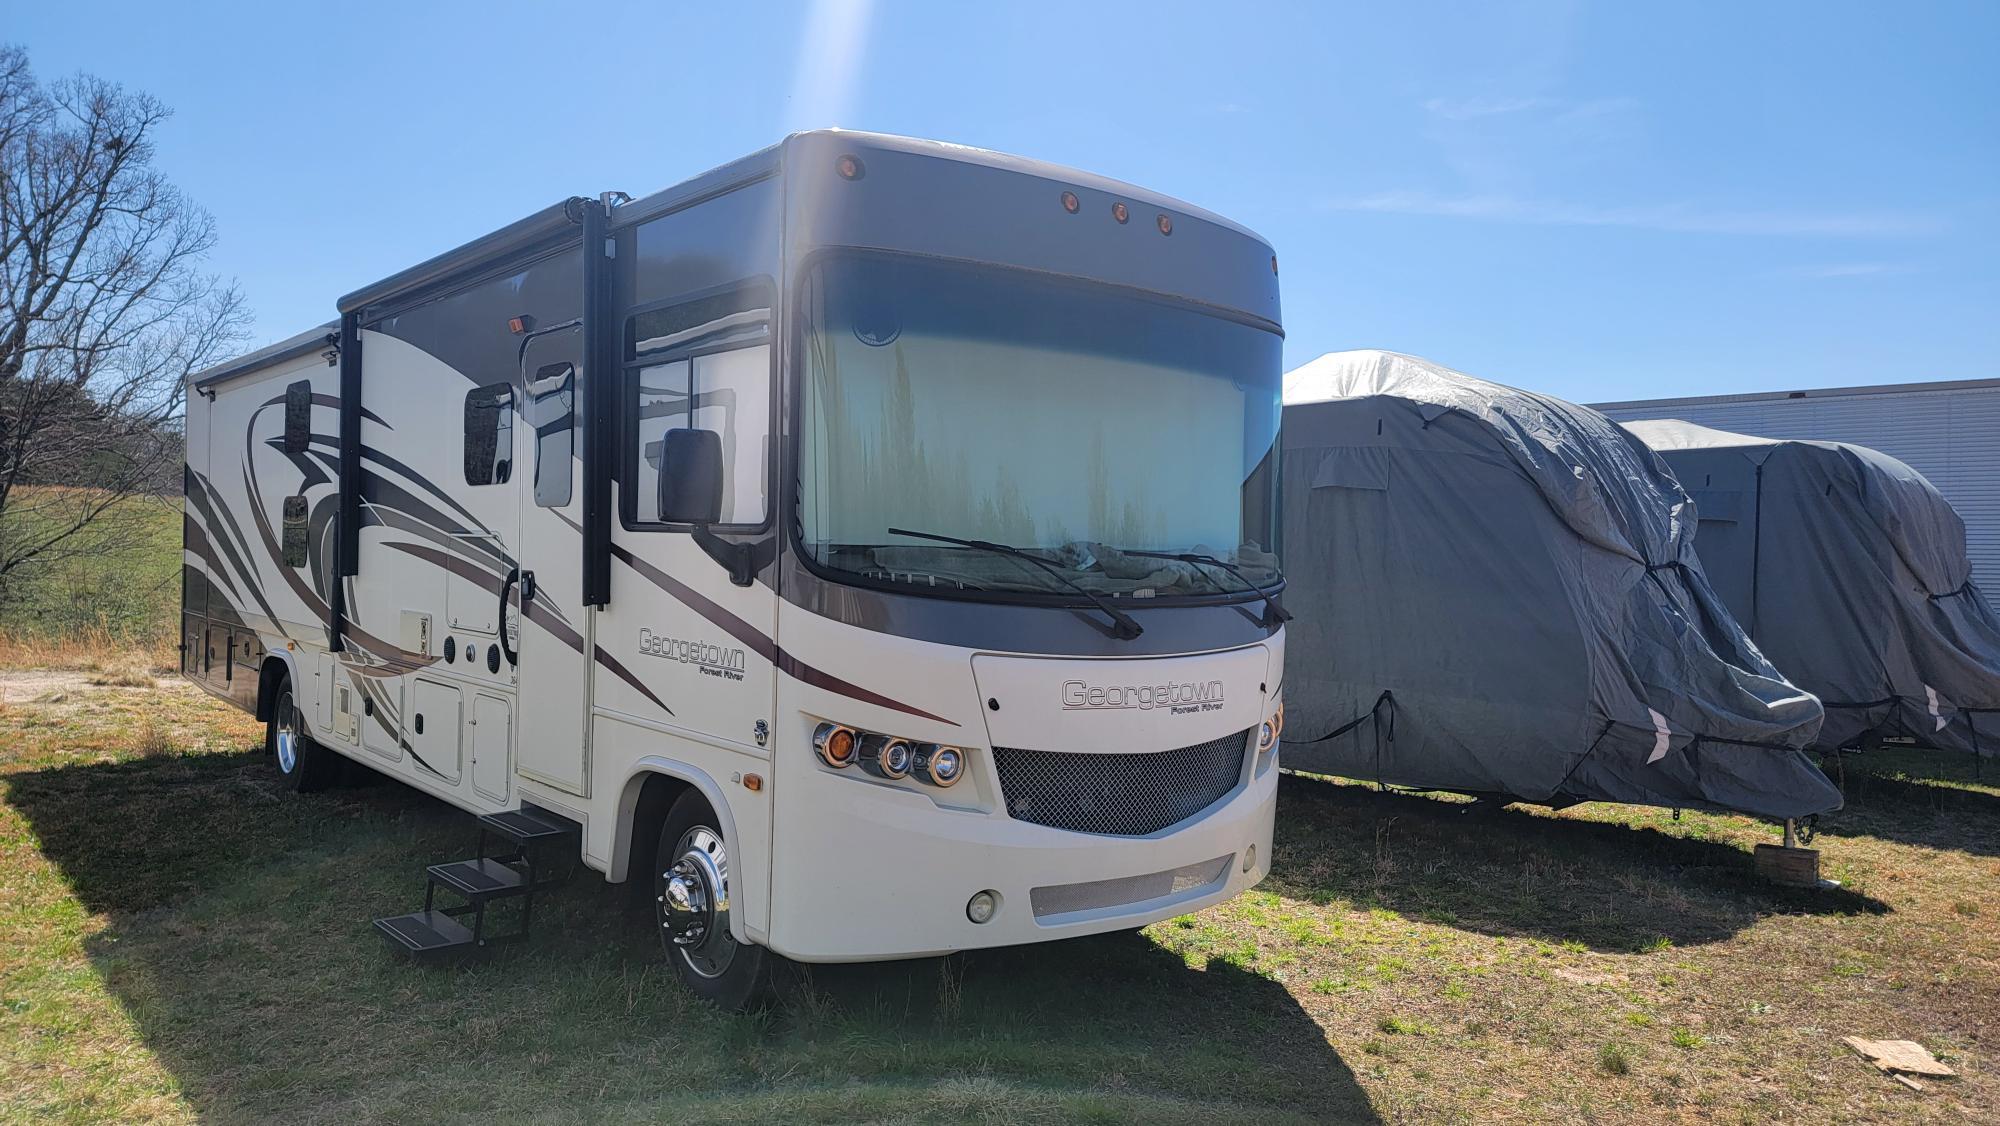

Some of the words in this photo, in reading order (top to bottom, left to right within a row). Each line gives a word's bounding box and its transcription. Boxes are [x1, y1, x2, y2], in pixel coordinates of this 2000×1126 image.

[639, 627, 745, 669] Georgetown
[699, 666, 723, 678] Forest
[723, 671, 744, 681] River
[1061, 679, 1224, 710] Georgetown
[1170, 705, 1200, 715] Forest
[1201, 703, 1223, 712] River
